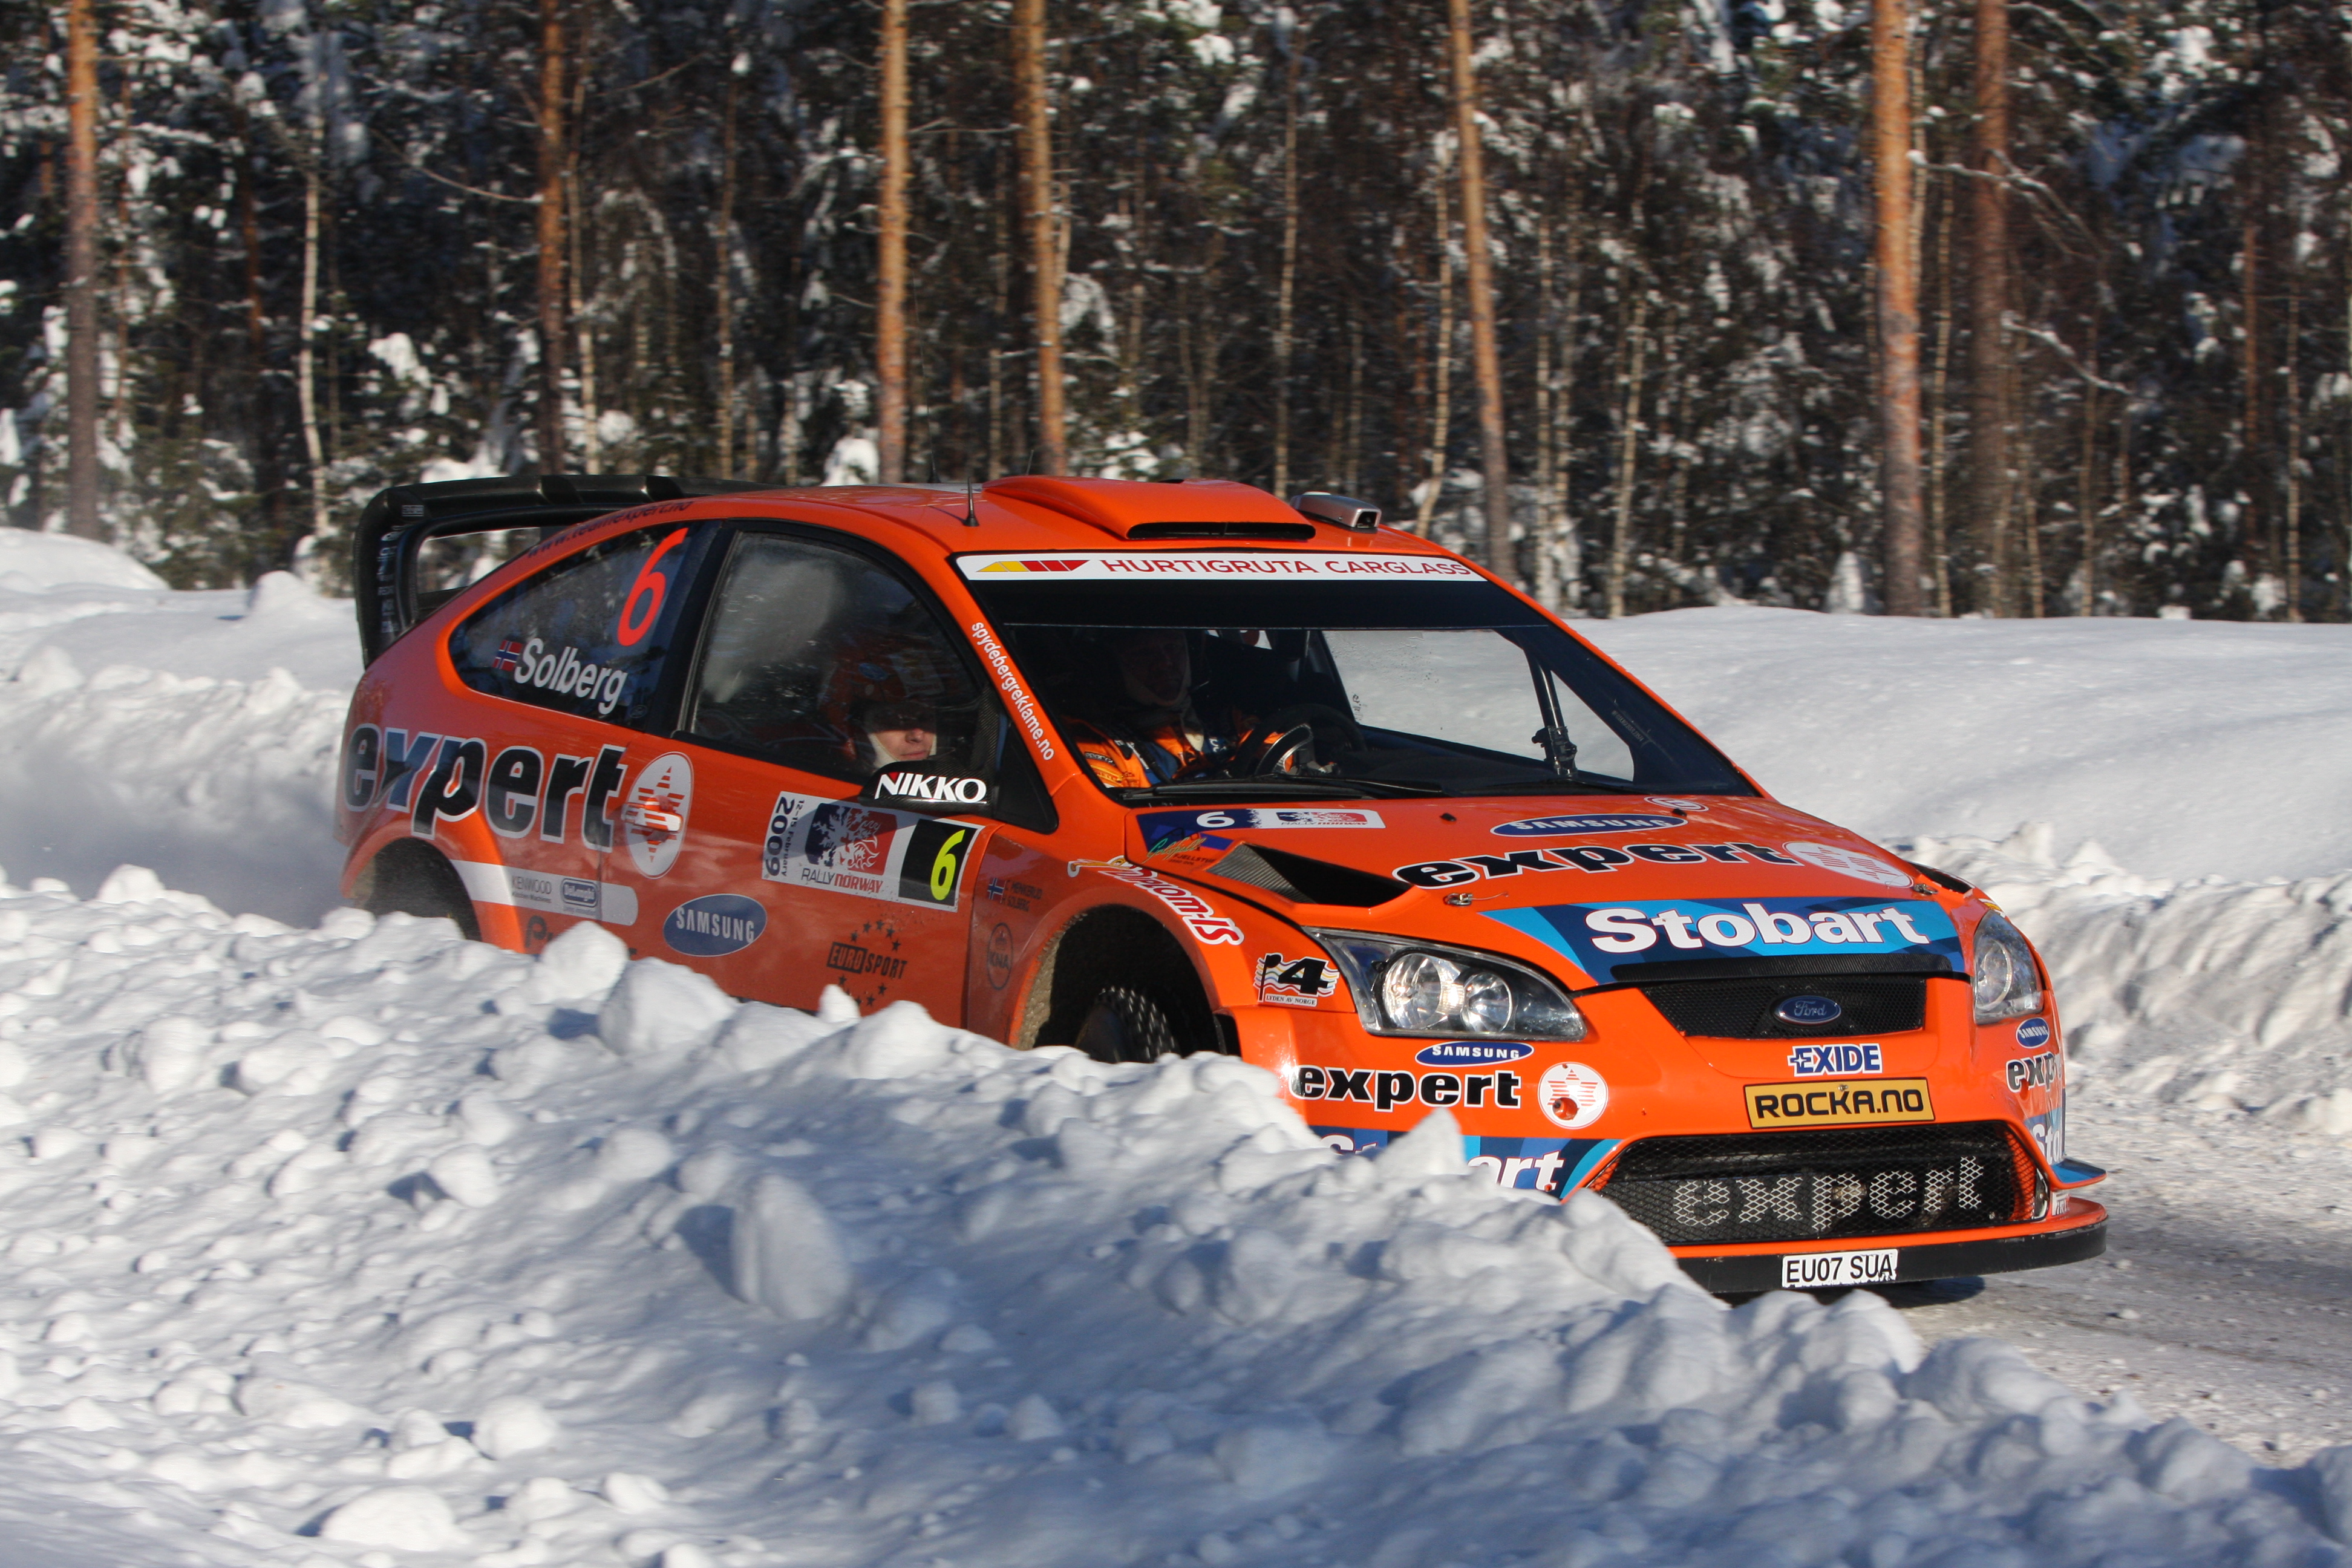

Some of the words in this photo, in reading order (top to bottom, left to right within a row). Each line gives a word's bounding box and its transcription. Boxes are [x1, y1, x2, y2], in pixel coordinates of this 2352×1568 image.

[617, 528, 688, 647] 6
[1100, 558, 1318, 575] HURTIGRUTA
[1324, 560, 1471, 577] CARGLASS
[514, 638, 628, 714] Solberg
[971, 621, 1054, 761] spydebergreklame.no
[345, 724, 629, 853] expert
[874, 772, 986, 804] NIKKO
[765, 796, 795, 877] 2009
[1197, 811, 1235, 828] 6
[1514, 817, 1673, 832] SAMSUNG
[801, 867, 835, 885] RALLY
[930, 829, 965, 901] 6
[1391, 841, 1805, 889] expert
[675, 907, 756, 944] SAMSUNG
[1584, 903, 1932, 954] Stobart
[1794, 1000, 1828, 1017] Ford
[1431, 1044, 1520, 1060] SAMSUNG
[1788, 1044, 1882, 1076] EXIDE
[1289, 1064, 1521, 1112] expert
[1673, 1156, 1984, 1232] expert
[1786, 1257, 1843, 1283] EU07
[1849, 1253, 1892, 1279] SUA
